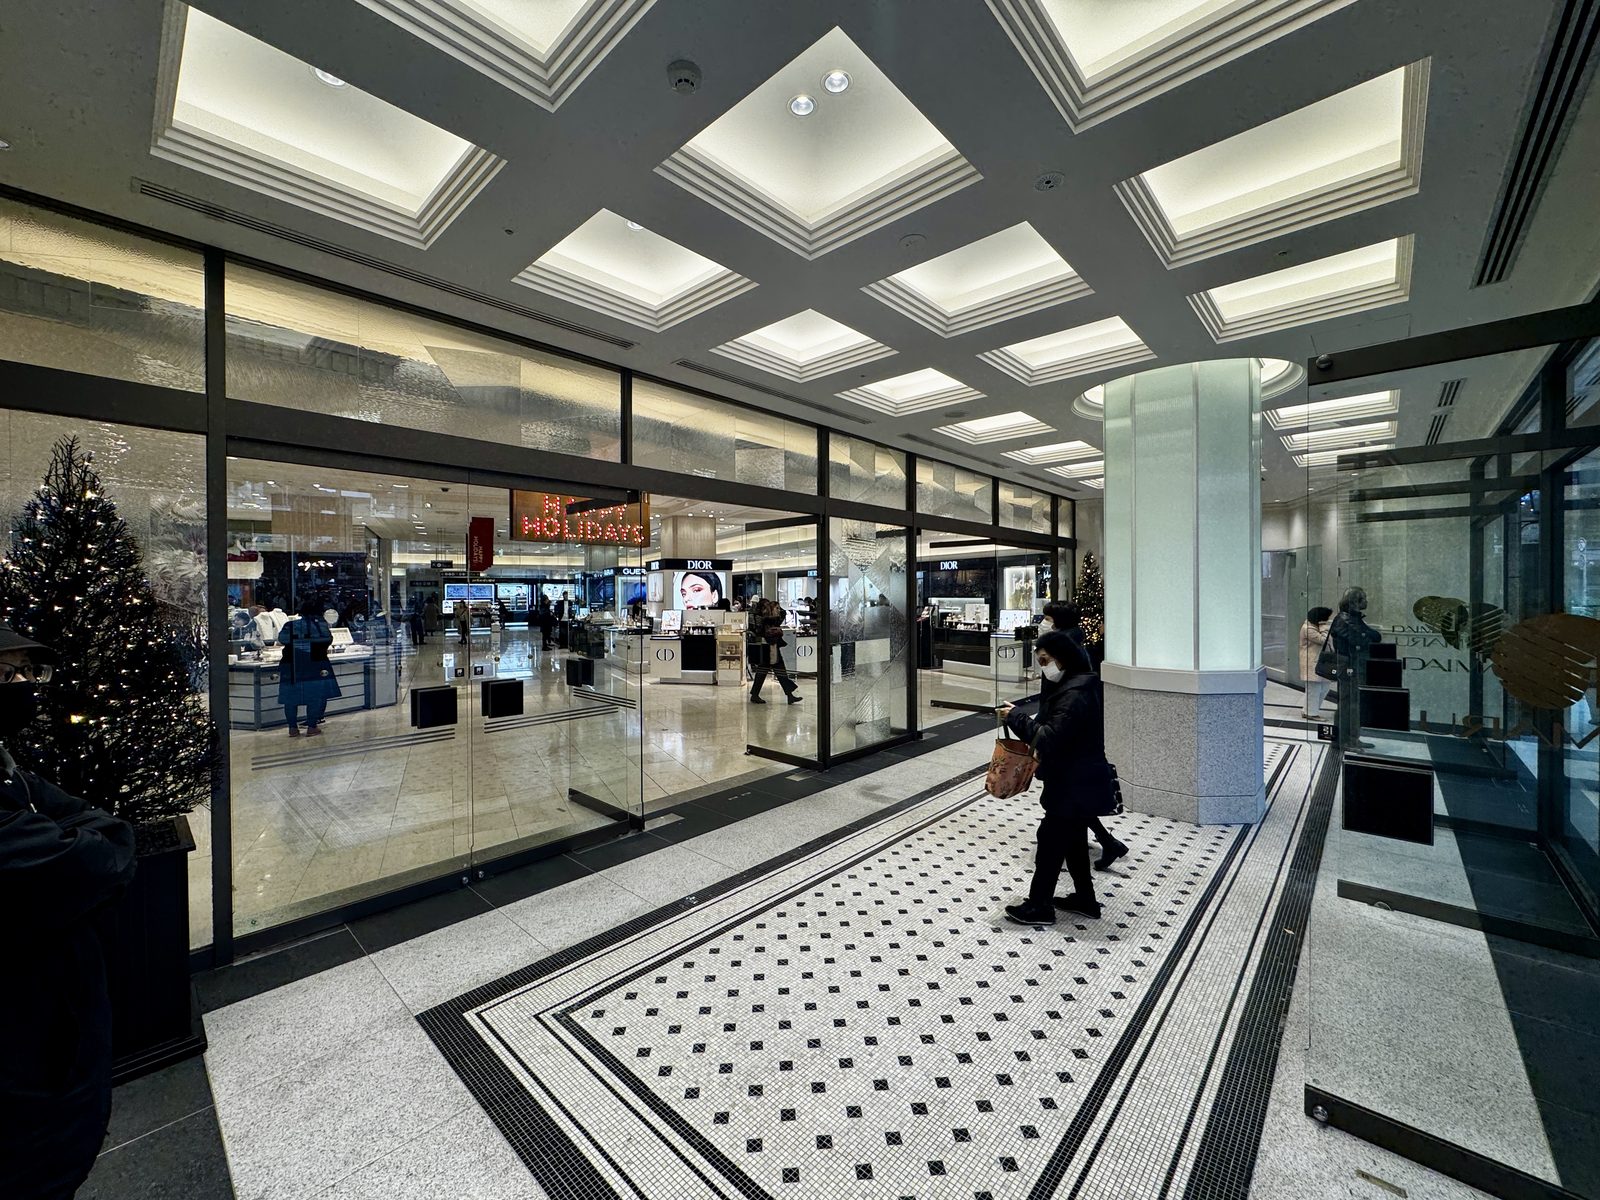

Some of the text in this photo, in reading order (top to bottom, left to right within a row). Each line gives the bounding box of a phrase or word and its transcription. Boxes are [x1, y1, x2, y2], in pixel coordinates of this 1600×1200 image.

[521, 515, 645, 543] HOLIDAYS
[687, 560, 713, 570] DIOR
[940, 561, 958, 570] DIOR
